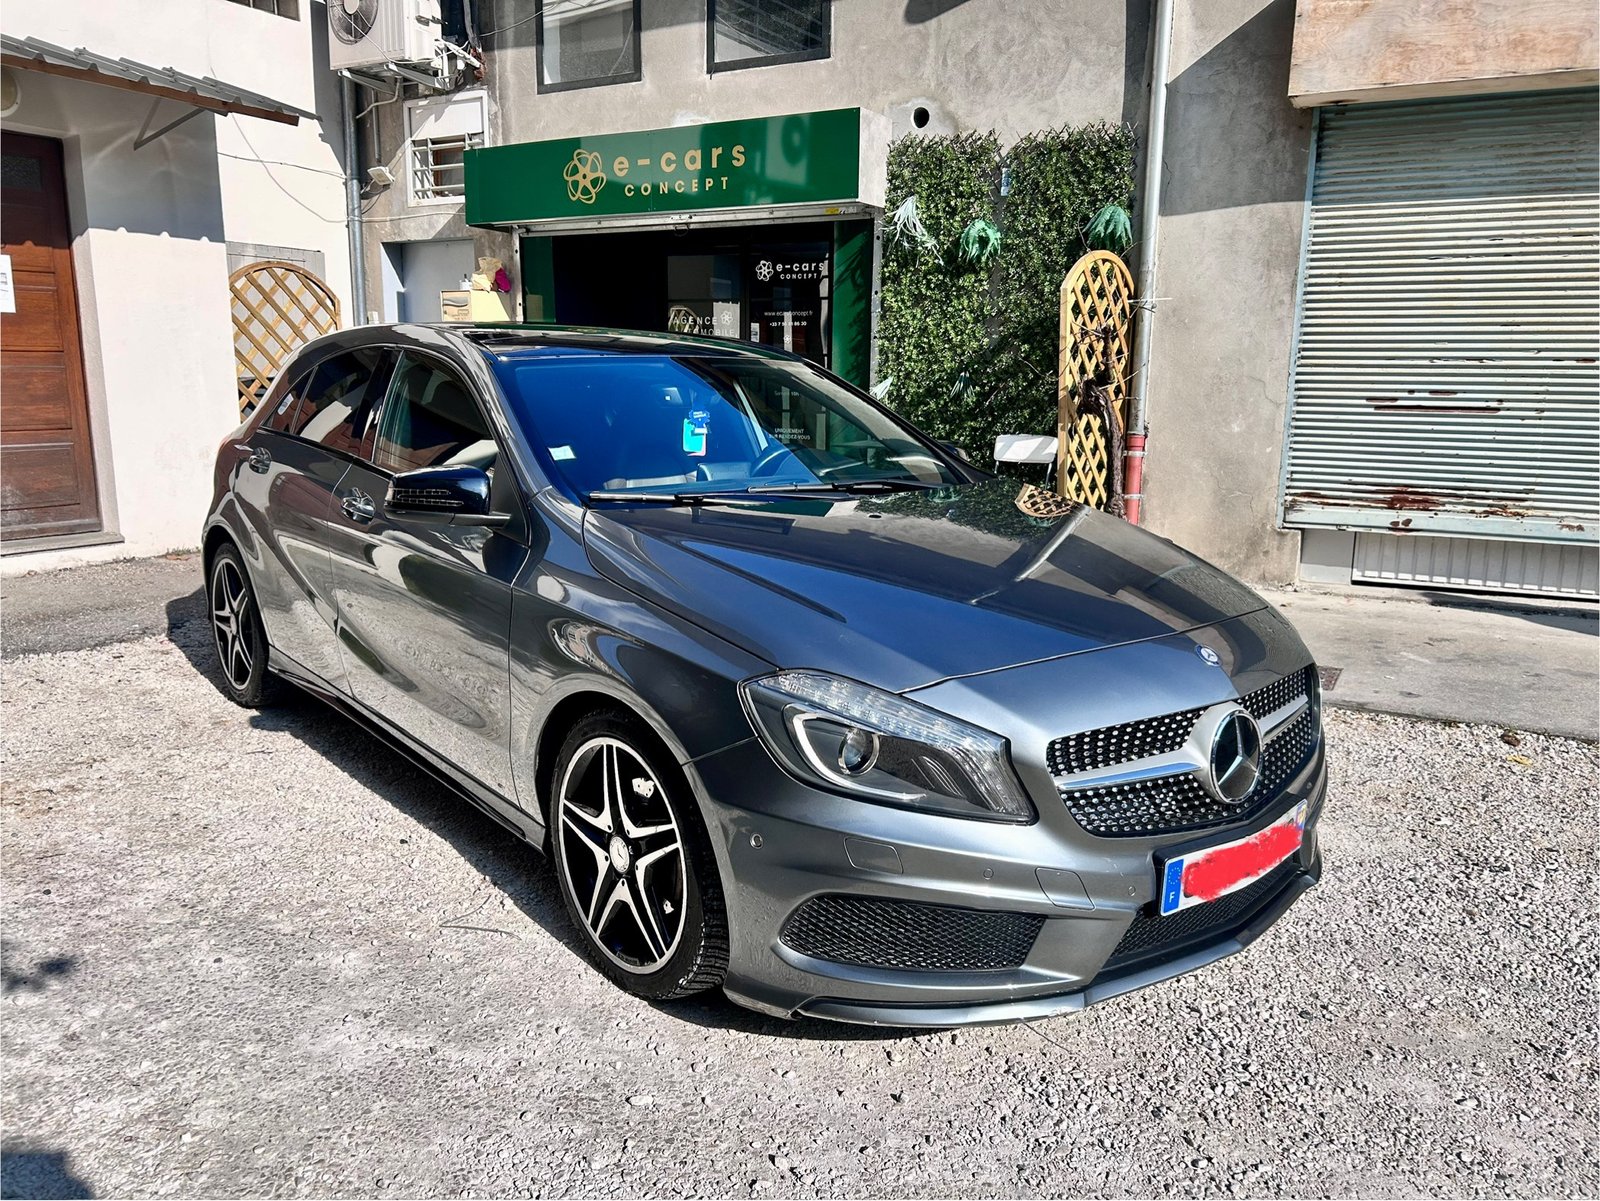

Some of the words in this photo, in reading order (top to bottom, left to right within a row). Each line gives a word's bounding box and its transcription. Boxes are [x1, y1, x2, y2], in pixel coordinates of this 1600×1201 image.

[613, 144, 746, 177] e-cars
[624, 176, 729, 197] CONCEPT
[775, 262, 825, 272] e-cars
[672, 316, 718, 325] AGENCE
[1168, 891, 1176, 904] F
